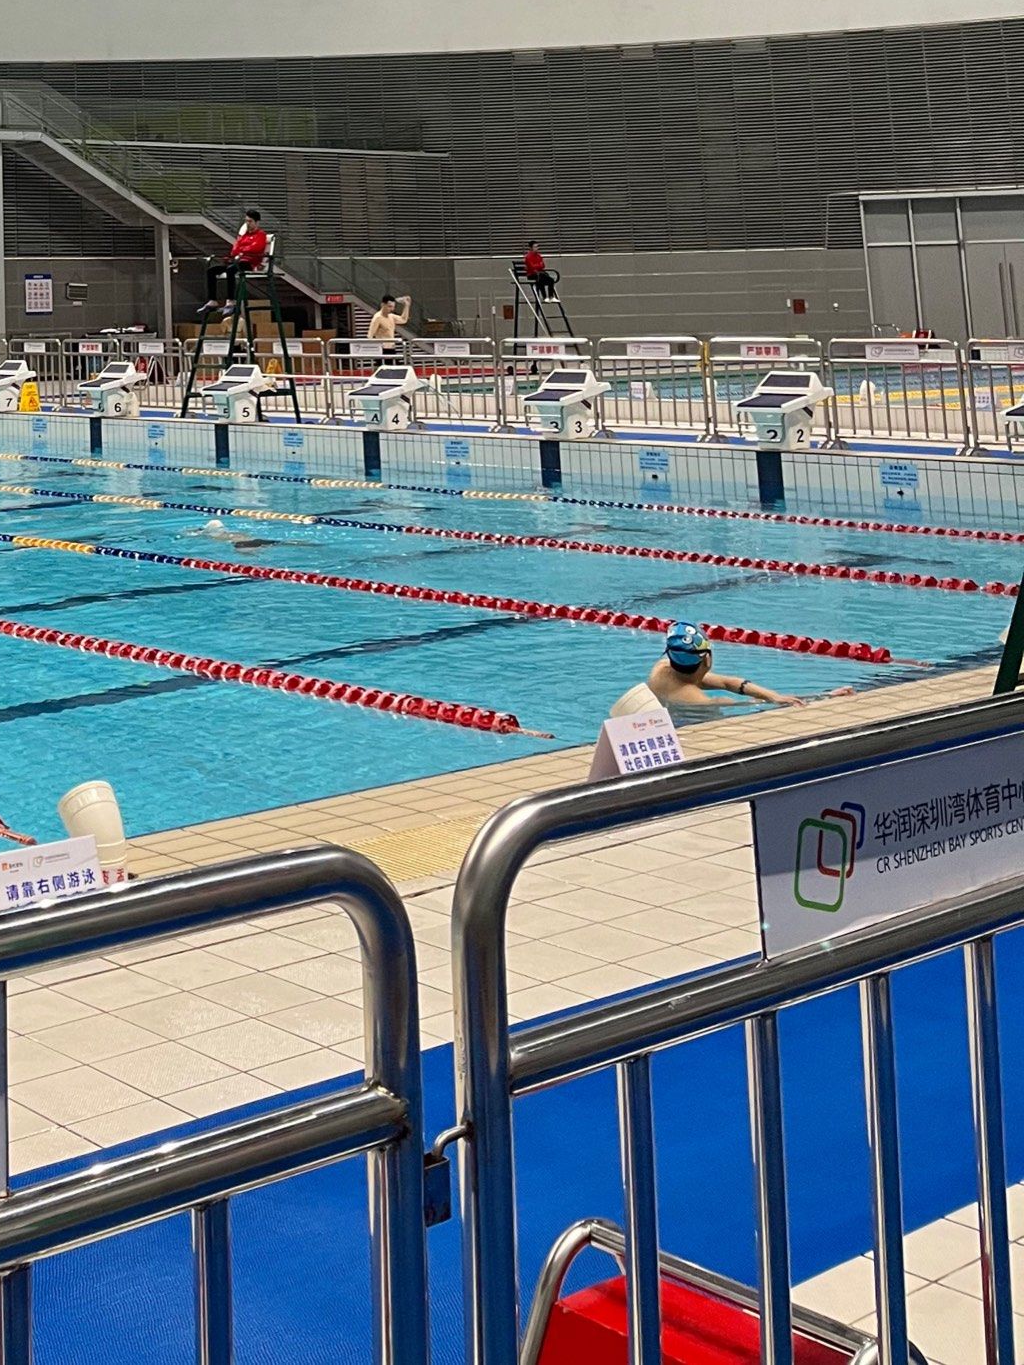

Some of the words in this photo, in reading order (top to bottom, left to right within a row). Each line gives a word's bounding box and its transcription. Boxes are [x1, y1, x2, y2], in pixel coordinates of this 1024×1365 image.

[6, 397, 13, 407] 7
[114, 402, 122, 413] 6
[242, 407, 250, 418] 5
[392, 413, 400, 425] 4
[575, 420, 583, 433] 3
[796, 428, 804, 443] 2
[876, 856, 892, 874] CR
[894, 841, 946, 869] SHENZHEN
[948, 834, 968, 853] BAY
[970, 822, 1004, 847] SPORTS
[1005, 815, 1024, 836] CEN
[5, 868, 96, 902] 请靠右侧游泳
